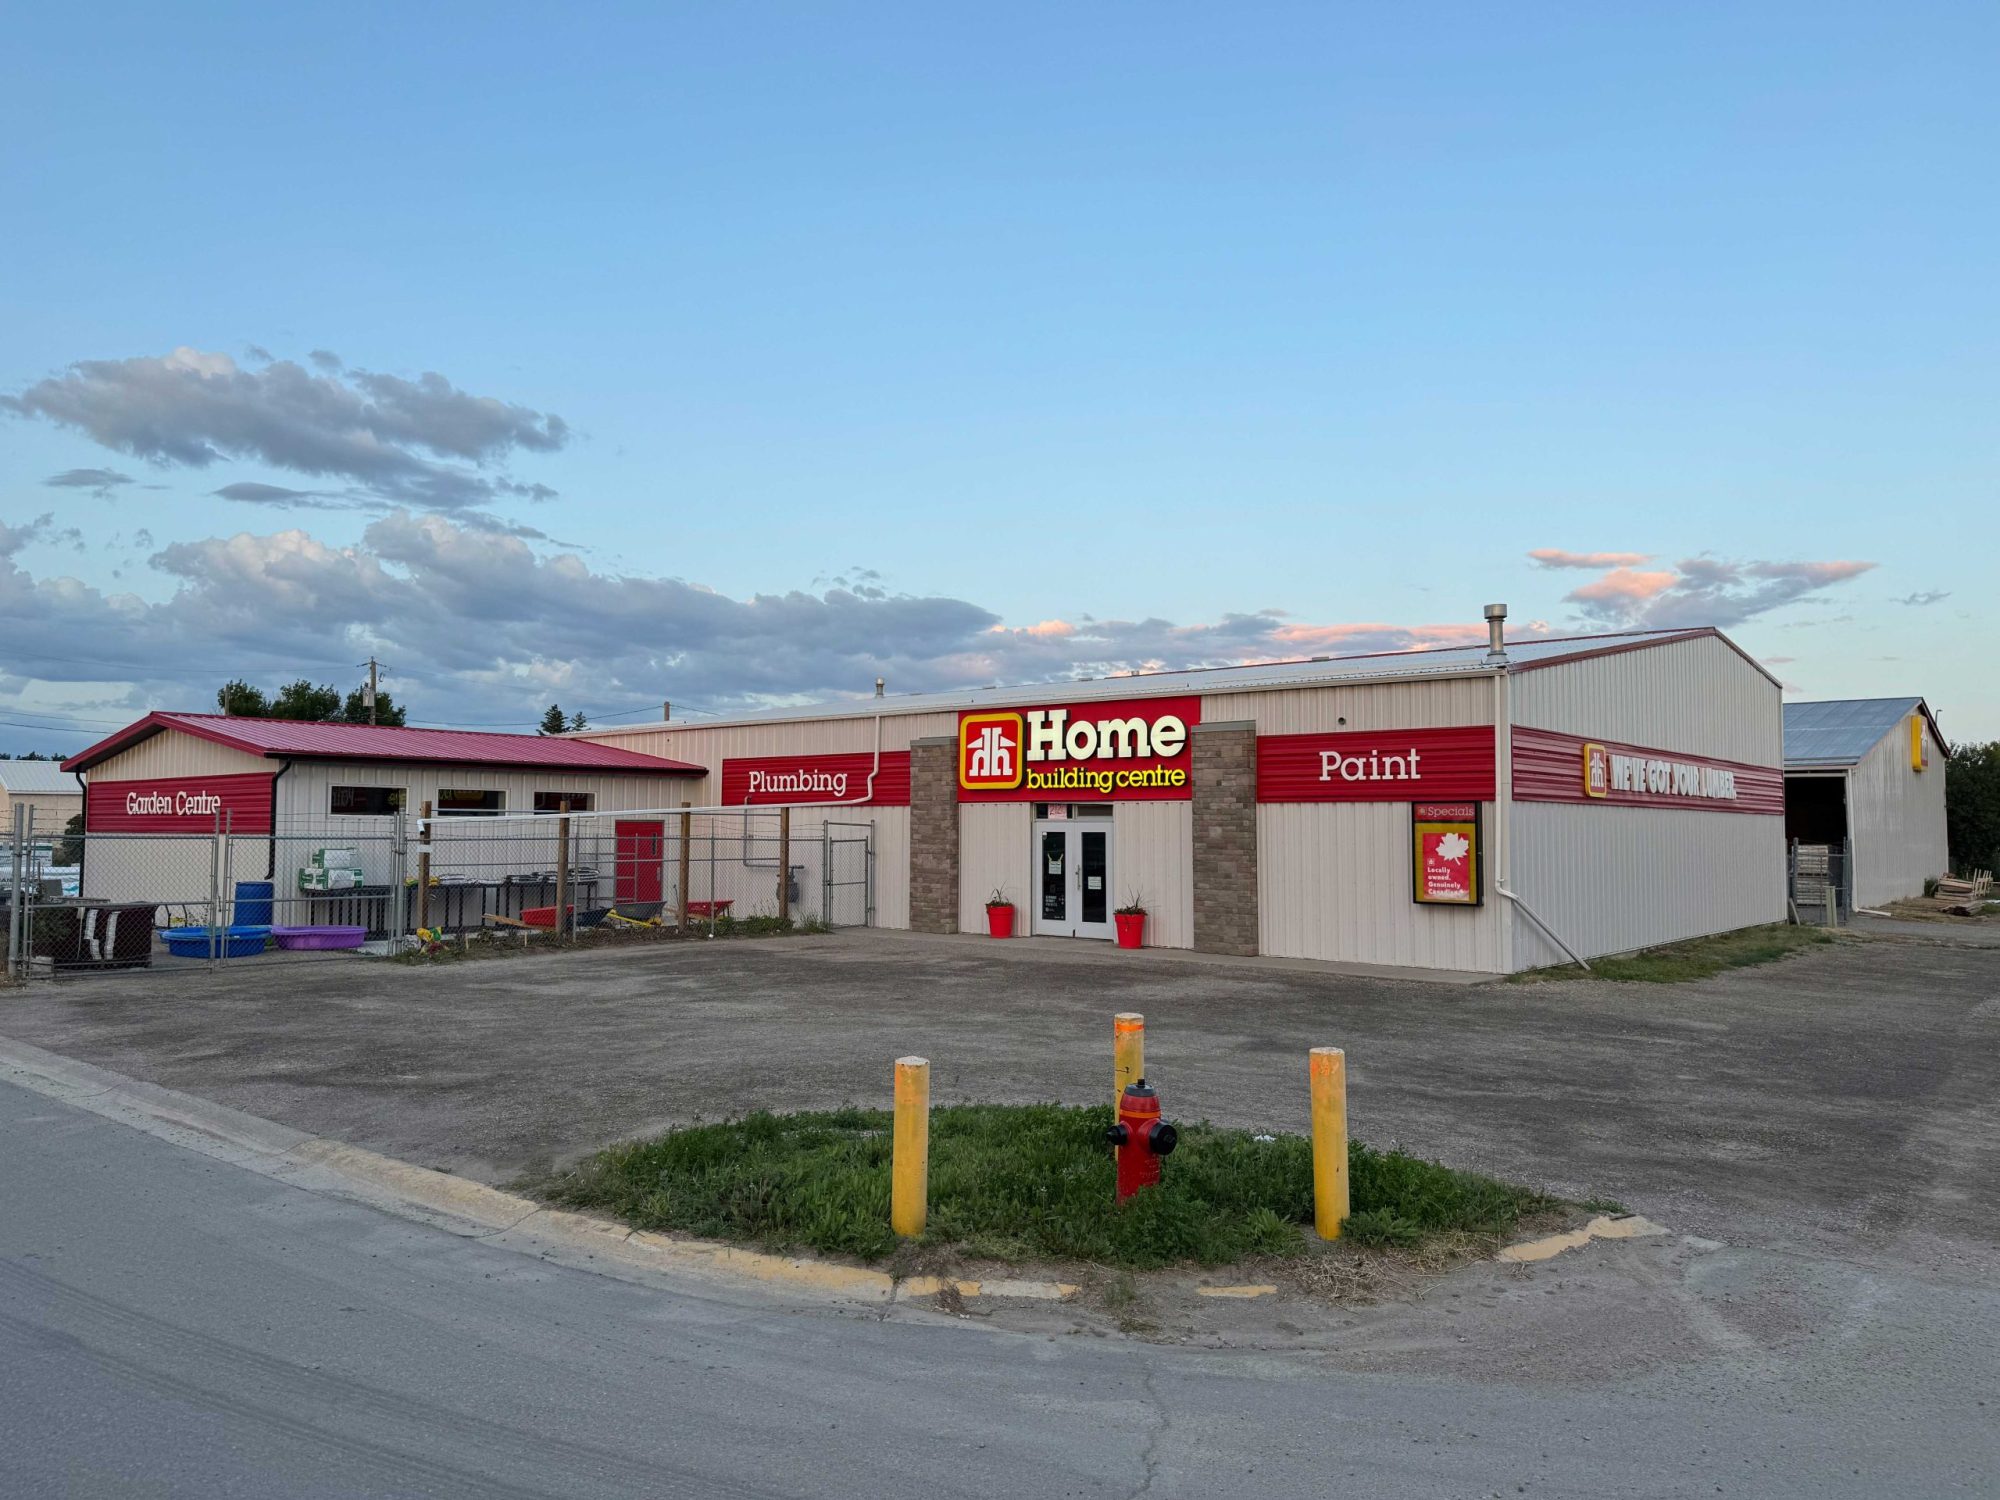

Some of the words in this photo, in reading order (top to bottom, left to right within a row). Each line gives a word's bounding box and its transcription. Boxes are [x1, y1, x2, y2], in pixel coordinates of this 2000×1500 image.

[1027, 709, 1187, 761] Home
[1319, 748, 1421, 781] Paint
[1647, 760, 1671, 794] GOT
[1672, 764, 1700, 797] YOUR
[749, 769, 847, 797] Plumbing
[1027, 768, 1115, 794] building
[1116, 765, 1186, 787] centre
[127, 791, 172, 815] Garden
[176, 790, 221, 816] Centre
[1428, 806, 1474, 817] Specials
[1428, 881, 1461, 889] Genuinely
